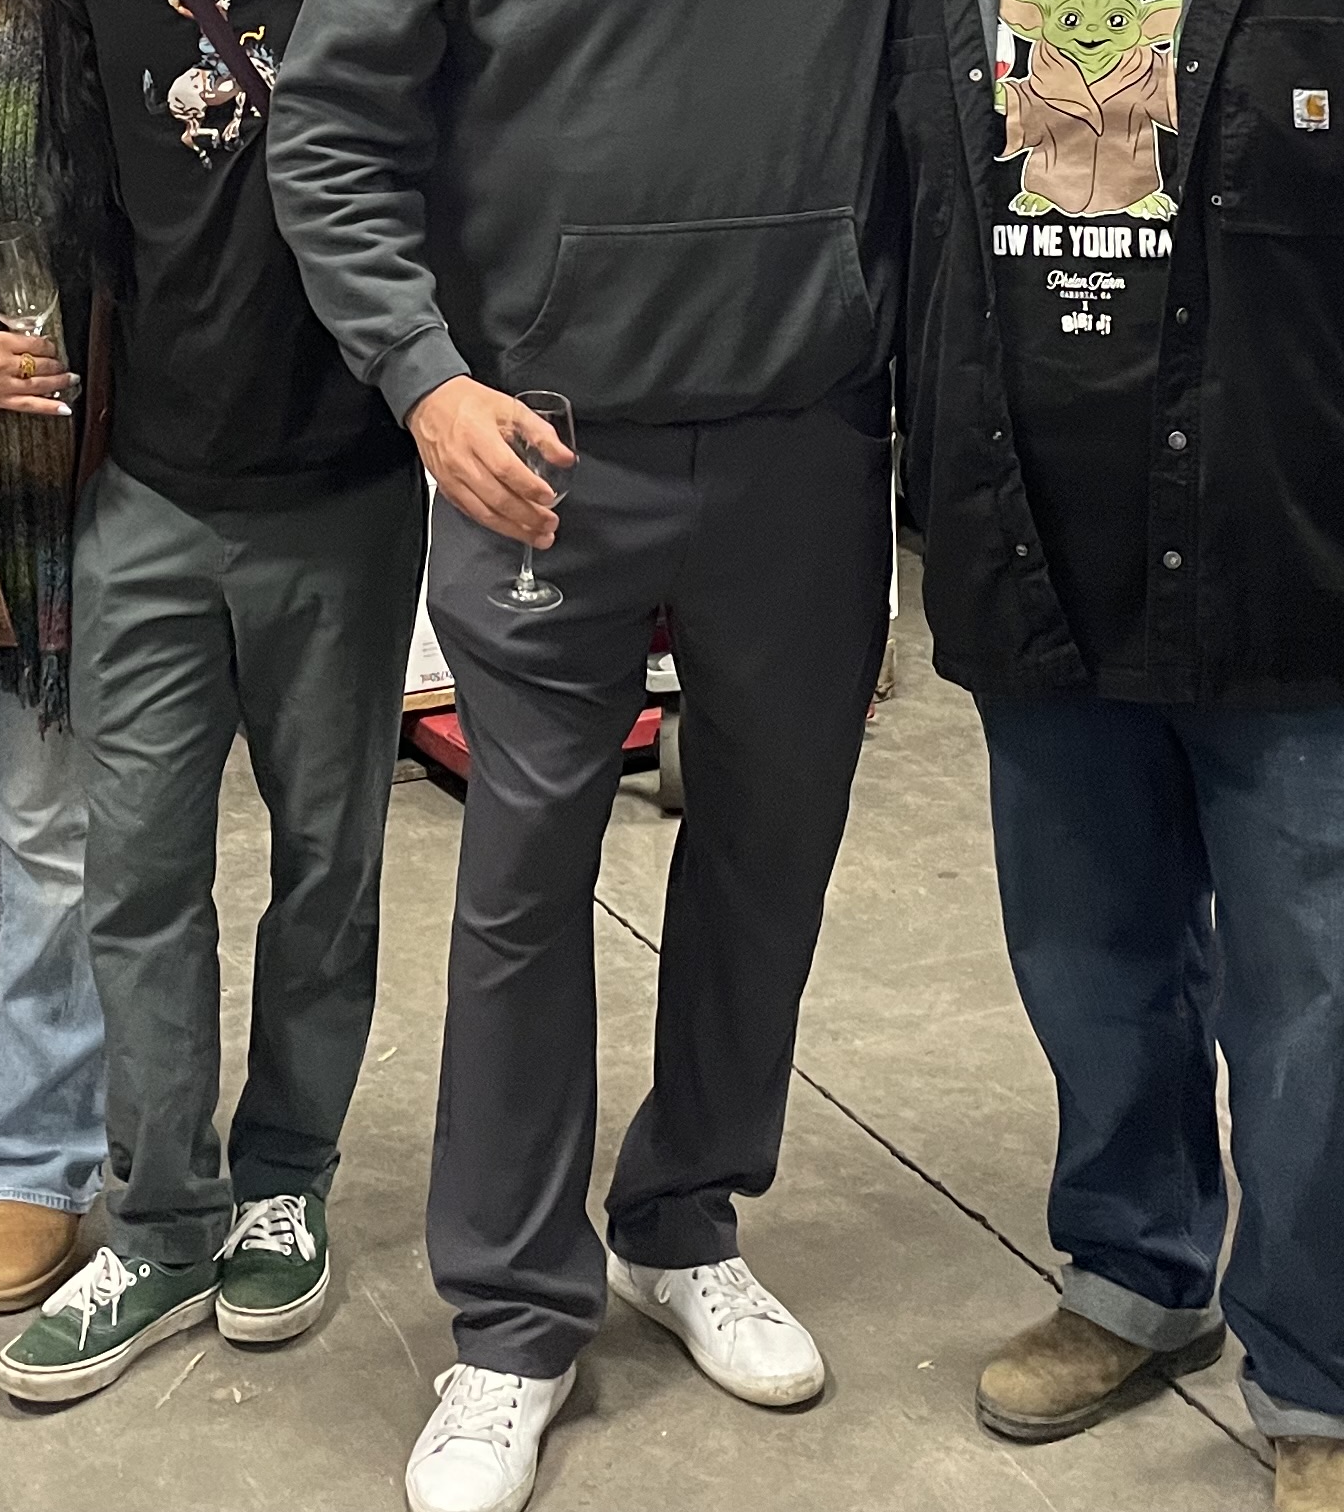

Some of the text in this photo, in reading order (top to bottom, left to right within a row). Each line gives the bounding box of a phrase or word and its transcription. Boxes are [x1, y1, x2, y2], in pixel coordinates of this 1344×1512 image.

[993, 224, 1173, 258] OW ME YOUR RA
[1087, 271, 1126, 291] Farm
